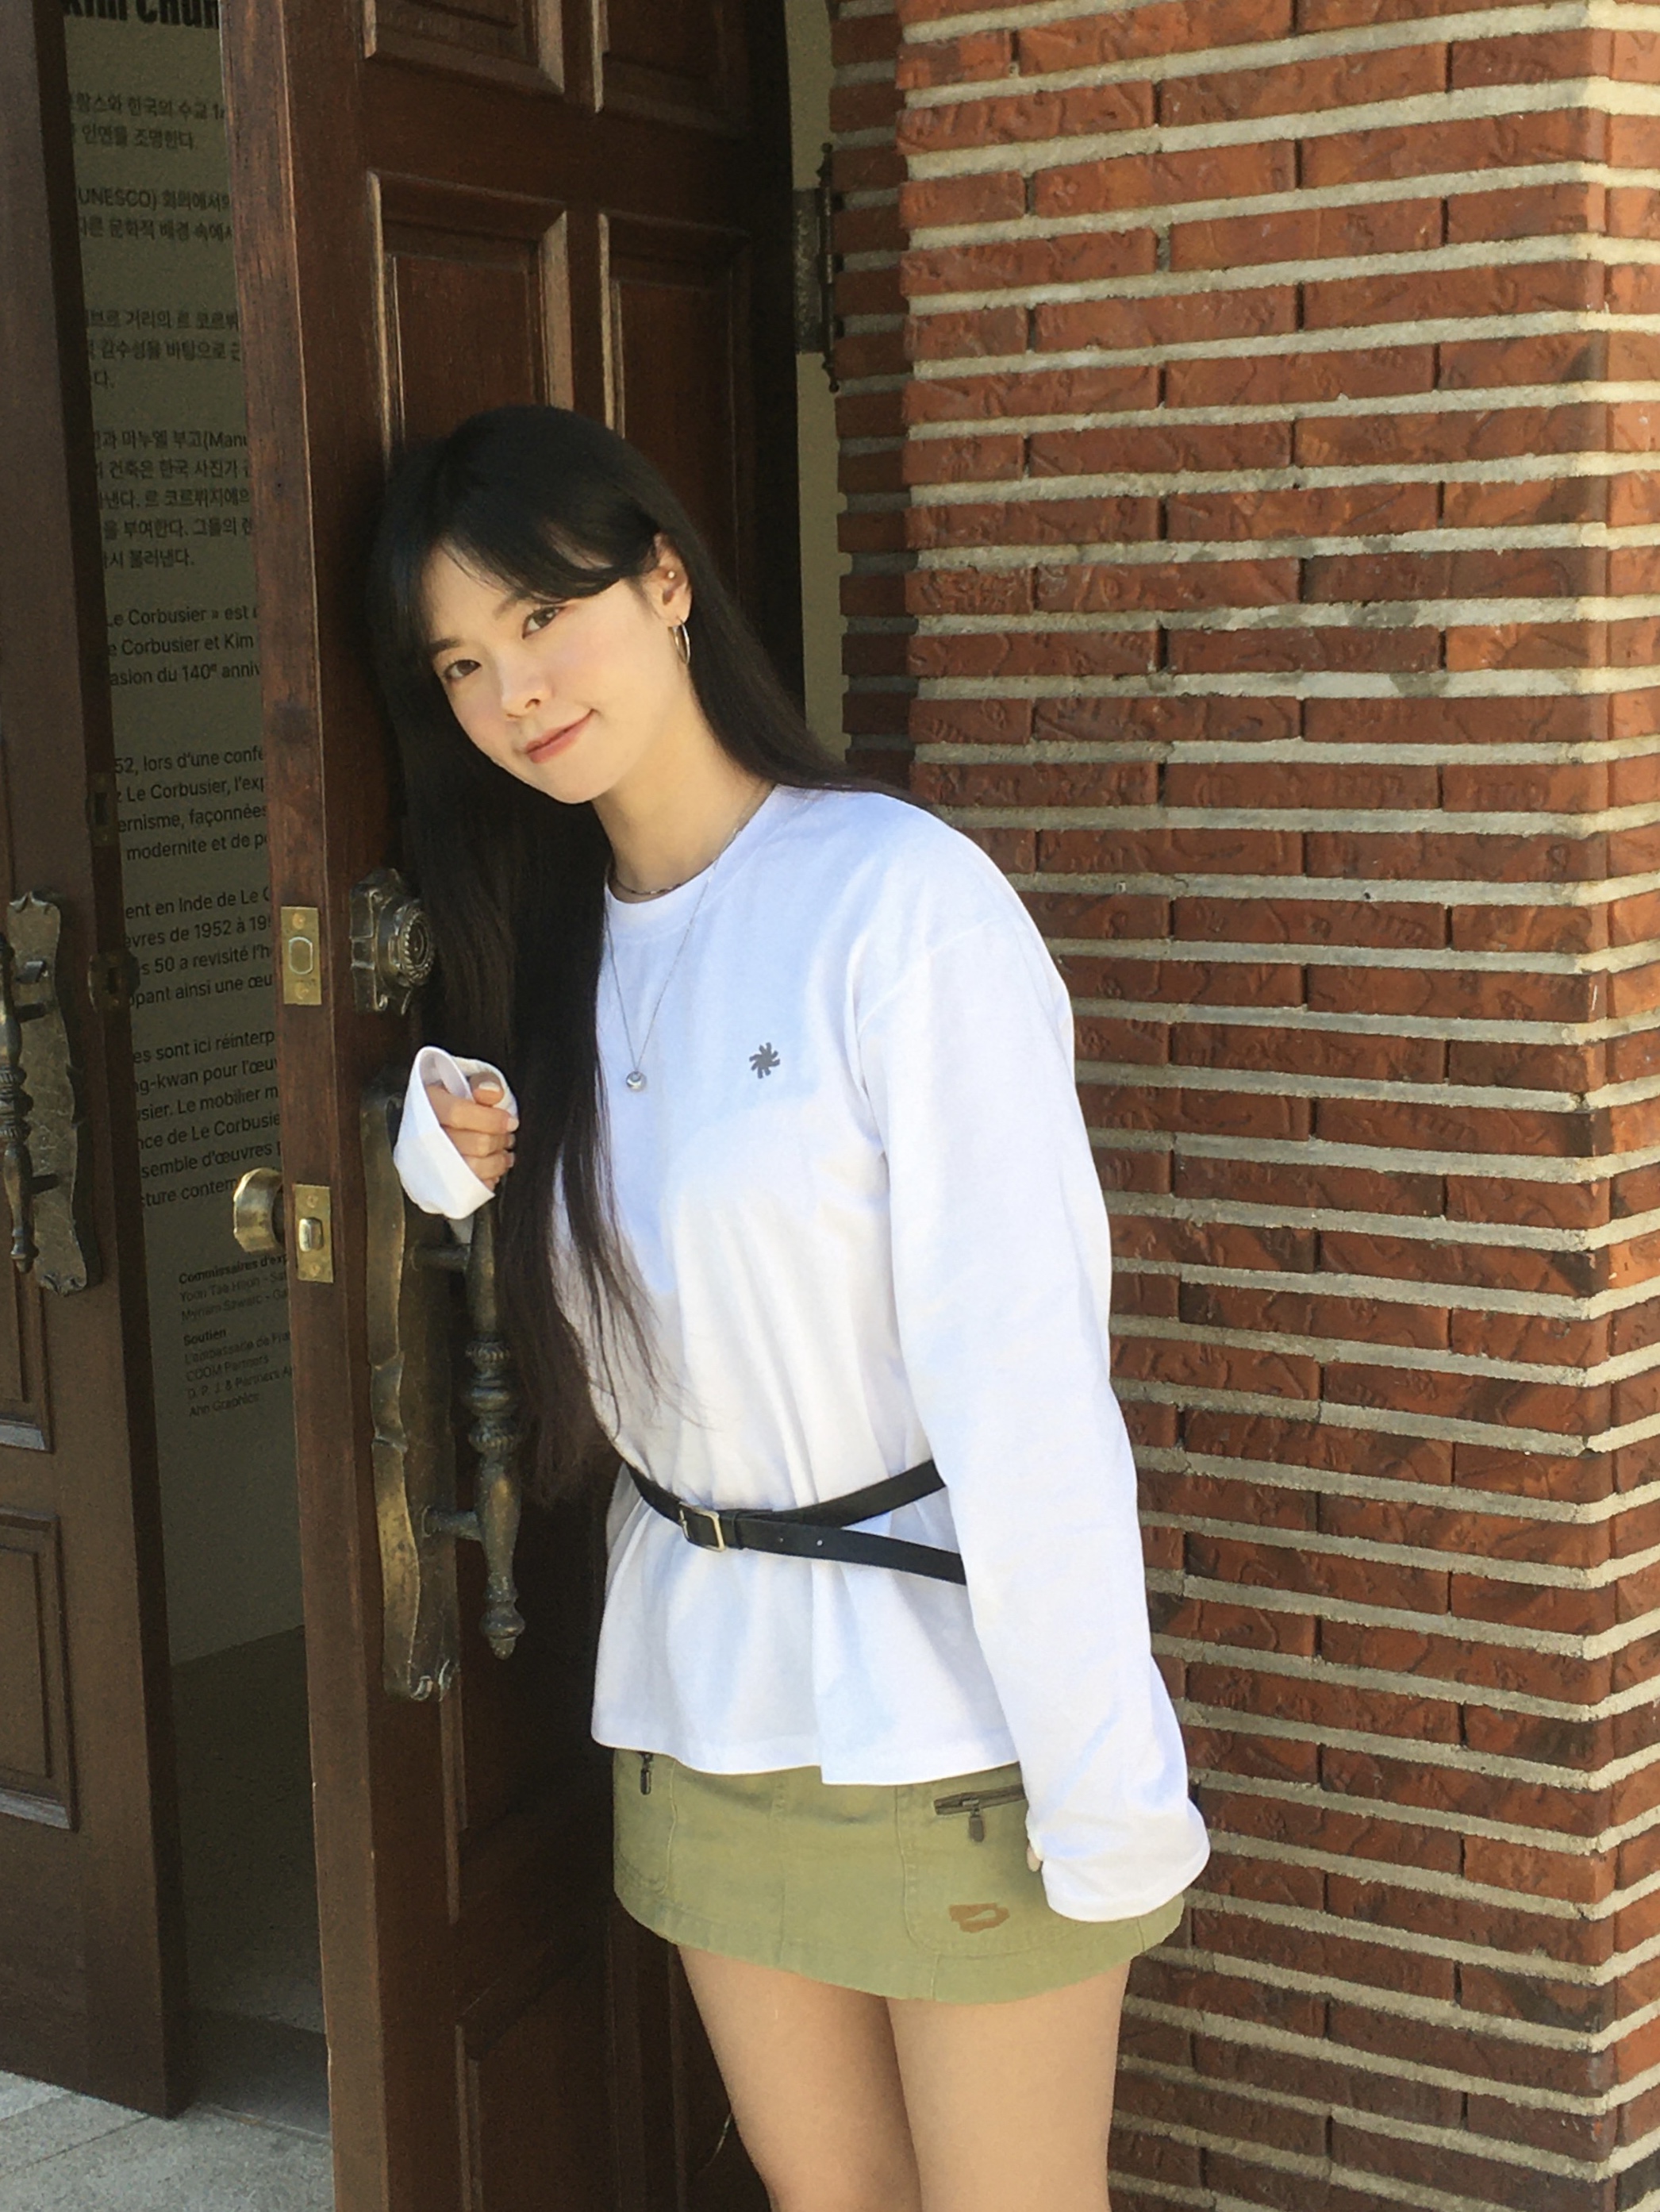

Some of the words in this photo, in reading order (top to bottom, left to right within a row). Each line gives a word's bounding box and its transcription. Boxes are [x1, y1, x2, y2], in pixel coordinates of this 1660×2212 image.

[71, 93, 121, 113] 랑스와
[128, 95, 172, 117] 한국의
[179, 100, 207, 119] 수교
[125, 310, 171, 329] 거리의
[166, 340, 226, 360] 바탕으로
[109, 460, 154, 479] 건축은
[159, 459, 189, 479] 한국
[129, 606, 206, 625] Corbusier
[225, 606, 248, 621] est
[122, 637, 199, 656] Corbusier
[204, 634, 220, 650] et
[225, 633, 253, 649] Kim
[157, 667, 177, 683] du
[144, 756, 172, 771] lors
[177, 752, 219, 768] d'une
[127, 787, 145, 802] Le
[151, 779, 231, 800] Corbusier,
[211, 837, 227, 851] et
[231, 833, 249, 848] de
[125, 902, 151, 919] ent
[156, 901, 175, 916] en
[179, 894, 213, 913] Inde
[217, 891, 236, 907] de
[240, 889, 258, 905] Le
[170, 927, 190, 943] de
[194, 919, 232, 939] 1952
[236, 917, 245, 934] à
[155, 956, 175, 974] 50
[180, 957, 188, 970] a
[193, 944, 248, 968] revisité
[175, 979, 211, 999] ainsi
[215, 978, 243, 994] une
[156, 1042, 190, 1061] sont
[194, 1037, 212, 1054] ici
[203, 1064, 237, 1085] pour
[178, 1099, 196, 1114] Le
[200, 1089, 260, 1111] mobilier
[167, 1129, 187, 1145] de
[192, 1125, 209, 1141] Le
[141, 1156, 198, 1179] semble
[179, 1260, 258, 1284] Commissaires
[183, 1329, 226, 1347] Soutien
